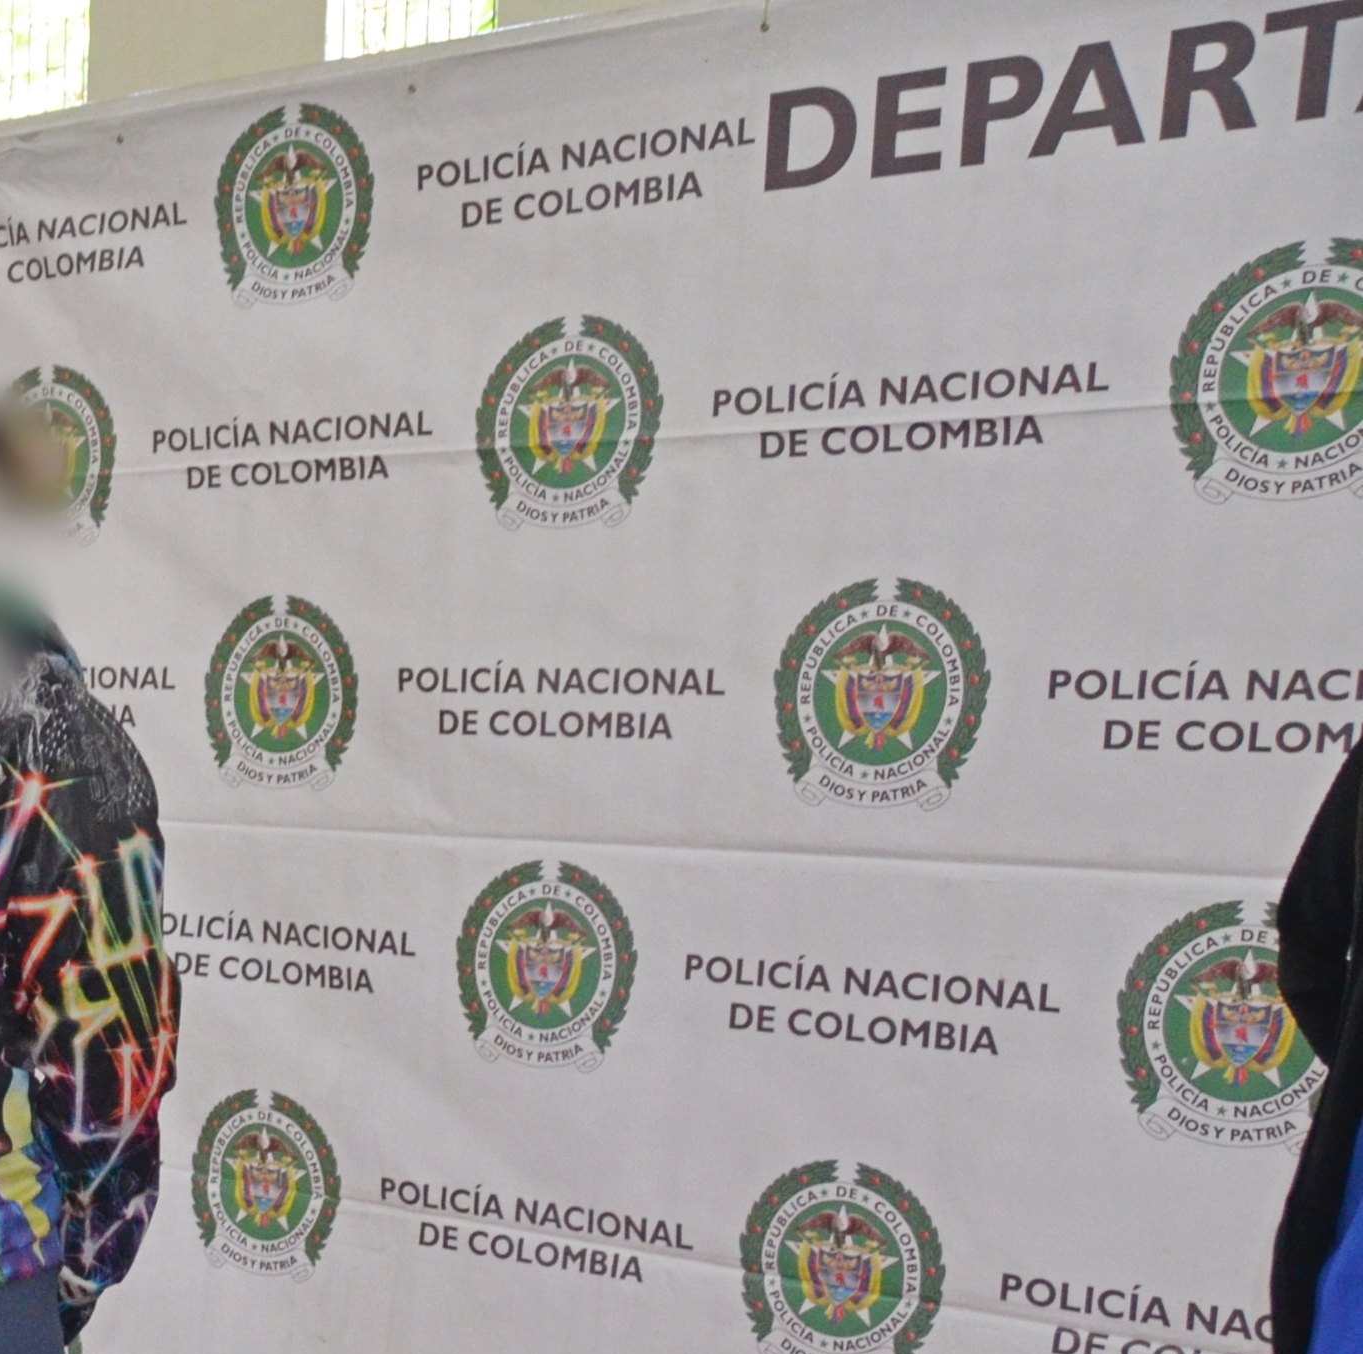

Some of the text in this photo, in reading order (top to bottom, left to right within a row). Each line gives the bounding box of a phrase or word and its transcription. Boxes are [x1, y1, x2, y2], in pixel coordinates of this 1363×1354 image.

[764, 0, 1363, 193] DEPART
[284, 127, 301, 139] DE
[418, 118, 755, 191] POLICÍA NACIONAL
[462, 171, 702, 228] DE COLOMBIA
[38, 202, 187, 242] NACIONAL
[8, 246, 144, 283] COLOMBIA
[292, 274, 334, 300] PATRIA
[1203, 269, 1330, 391] REPUBLICA DE
[500, 340, 638, 437] REPUBLICA DE COLOMBIA
[713, 362, 1109, 417] POLICÍA NACIONAL
[67, 393, 99, 464] COLOMBIA
[153, 411, 432, 453] POLICÍA NACIONAL
[760, 415, 1043, 459] DE COLOMBIA
[187, 455, 388, 489] DE COLOMBIA
[563, 450, 629, 503] NACIONAL
[1225, 462, 1363, 494] DIOS Y PATRIA
[516, 498, 610, 523] DIOS Y PATRIA
[274, 617, 290, 628] DE
[800, 604, 961, 708] REPUBLICA DE COLOMBIA
[83, 666, 176, 690] IONAL
[398, 660, 725, 695] POLICÍA NACIONAL
[1048, 661, 1229, 700] POLICÍA
[439, 710, 672, 739] DE COLOMBIA
[1104, 720, 1362, 754] DE COLOM
[276, 764, 317, 784] PATRIA
[873, 729, 950, 781] NACIONAL
[819, 775, 927, 803] DIOS Y PATRIA
[263, 921, 415, 956] NACIONAL
[478, 884, 613, 982] REPUBLICA DE COLOMBIA
[175, 952, 374, 993] DE COLOMBIA
[685, 954, 1060, 1013] POLICÍA NACIONAL
[1148, 929, 1267, 1030] REPUBLICA DE
[539, 1000, 604, 1043] NACIONAL
[729, 1003, 998, 1055] DE COLOMBIA
[493, 1034, 584, 1063] DIOS Y PATRIA
[1233, 1068, 1326, 1118] NACIONAL
[258, 1110, 274, 1123] DE
[1168, 1107, 1298, 1142] DIOS Y PATRIA
[381, 1177, 693, 1250] POLICÍA NACIONAL
[419, 1222, 642, 1283] DE COLOMBIA
[764, 1186, 918, 1294] REPUBLICA DE COLOMBIA
[259, 1255, 298, 1271] PATRIA
[1000, 1273, 1170, 1327] POLICÍA
[833, 1312, 907, 1352] NACIONAL
